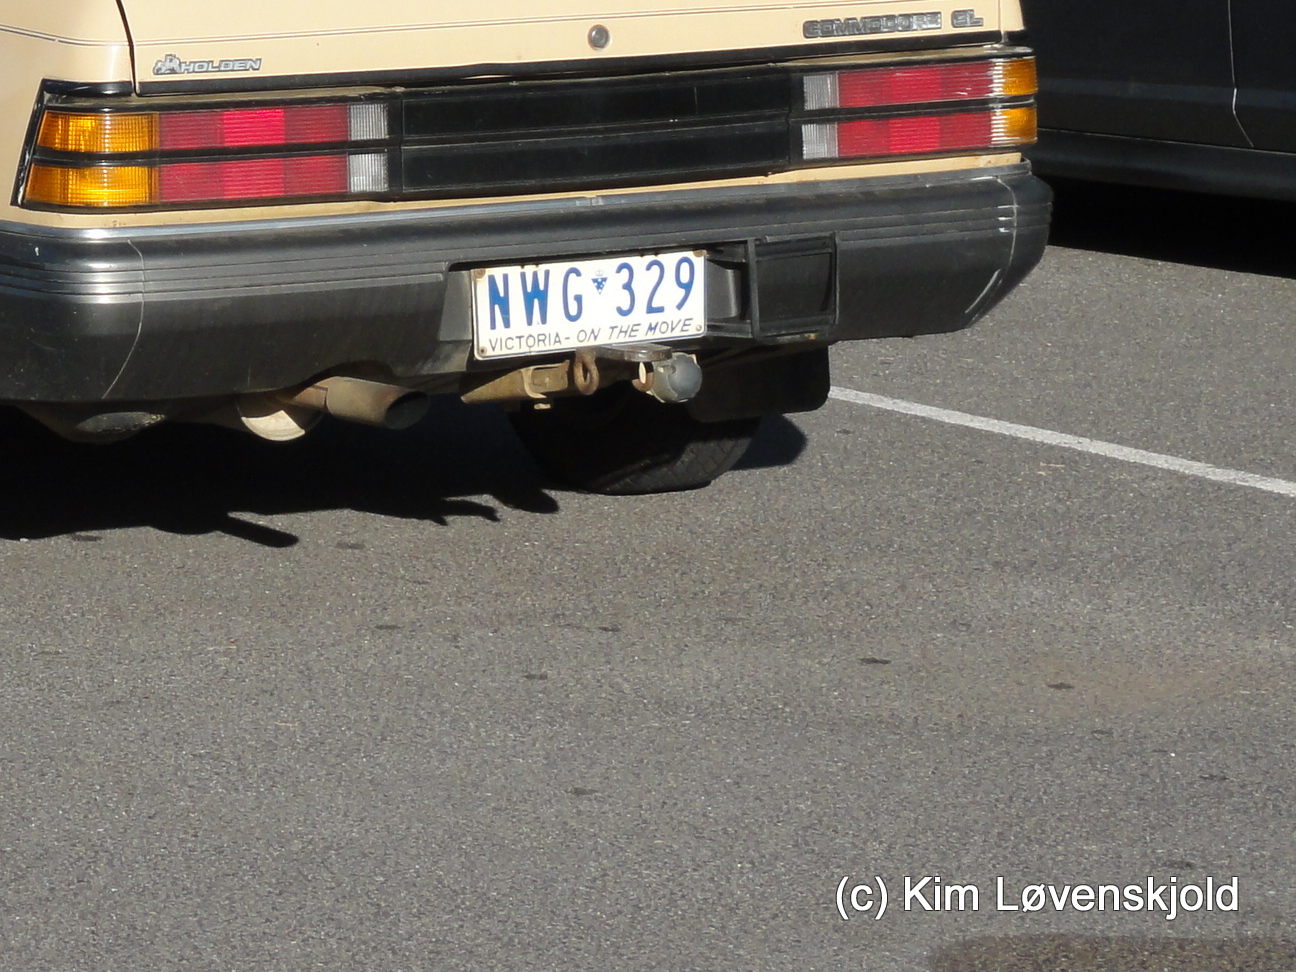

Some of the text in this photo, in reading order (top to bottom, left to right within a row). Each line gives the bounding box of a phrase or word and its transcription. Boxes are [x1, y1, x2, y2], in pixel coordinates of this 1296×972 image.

[802, 10, 942, 39] COMMODORE
[179, 57, 263, 75] HOLDEN
[487, 256, 696, 331] NWG 329
[576, 327, 601, 344] ON
[608, 322, 643, 340] THE
[646, 317, 694, 337] MOVE
